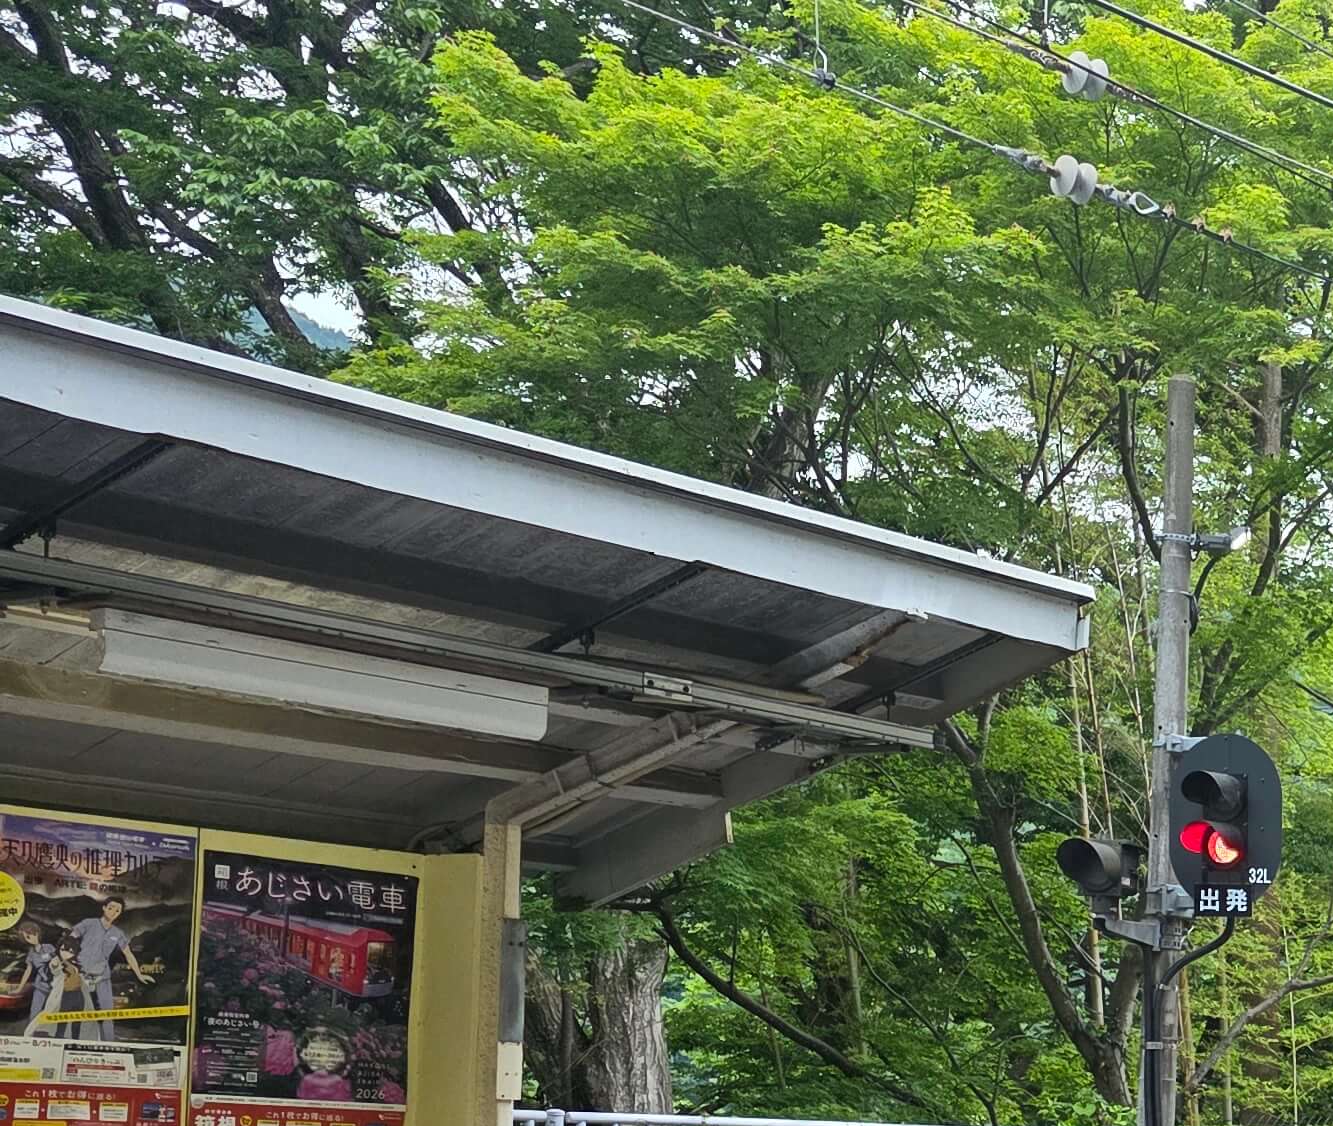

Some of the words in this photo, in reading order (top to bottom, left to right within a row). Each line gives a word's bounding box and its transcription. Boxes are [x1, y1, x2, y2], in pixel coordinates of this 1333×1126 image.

[1248, 867, 1272, 884] 32L
[235, 867, 407, 913] あじさい電車
[1199, 887, 1248, 912] 出発
[355, 1088, 385, 1100] 2026
